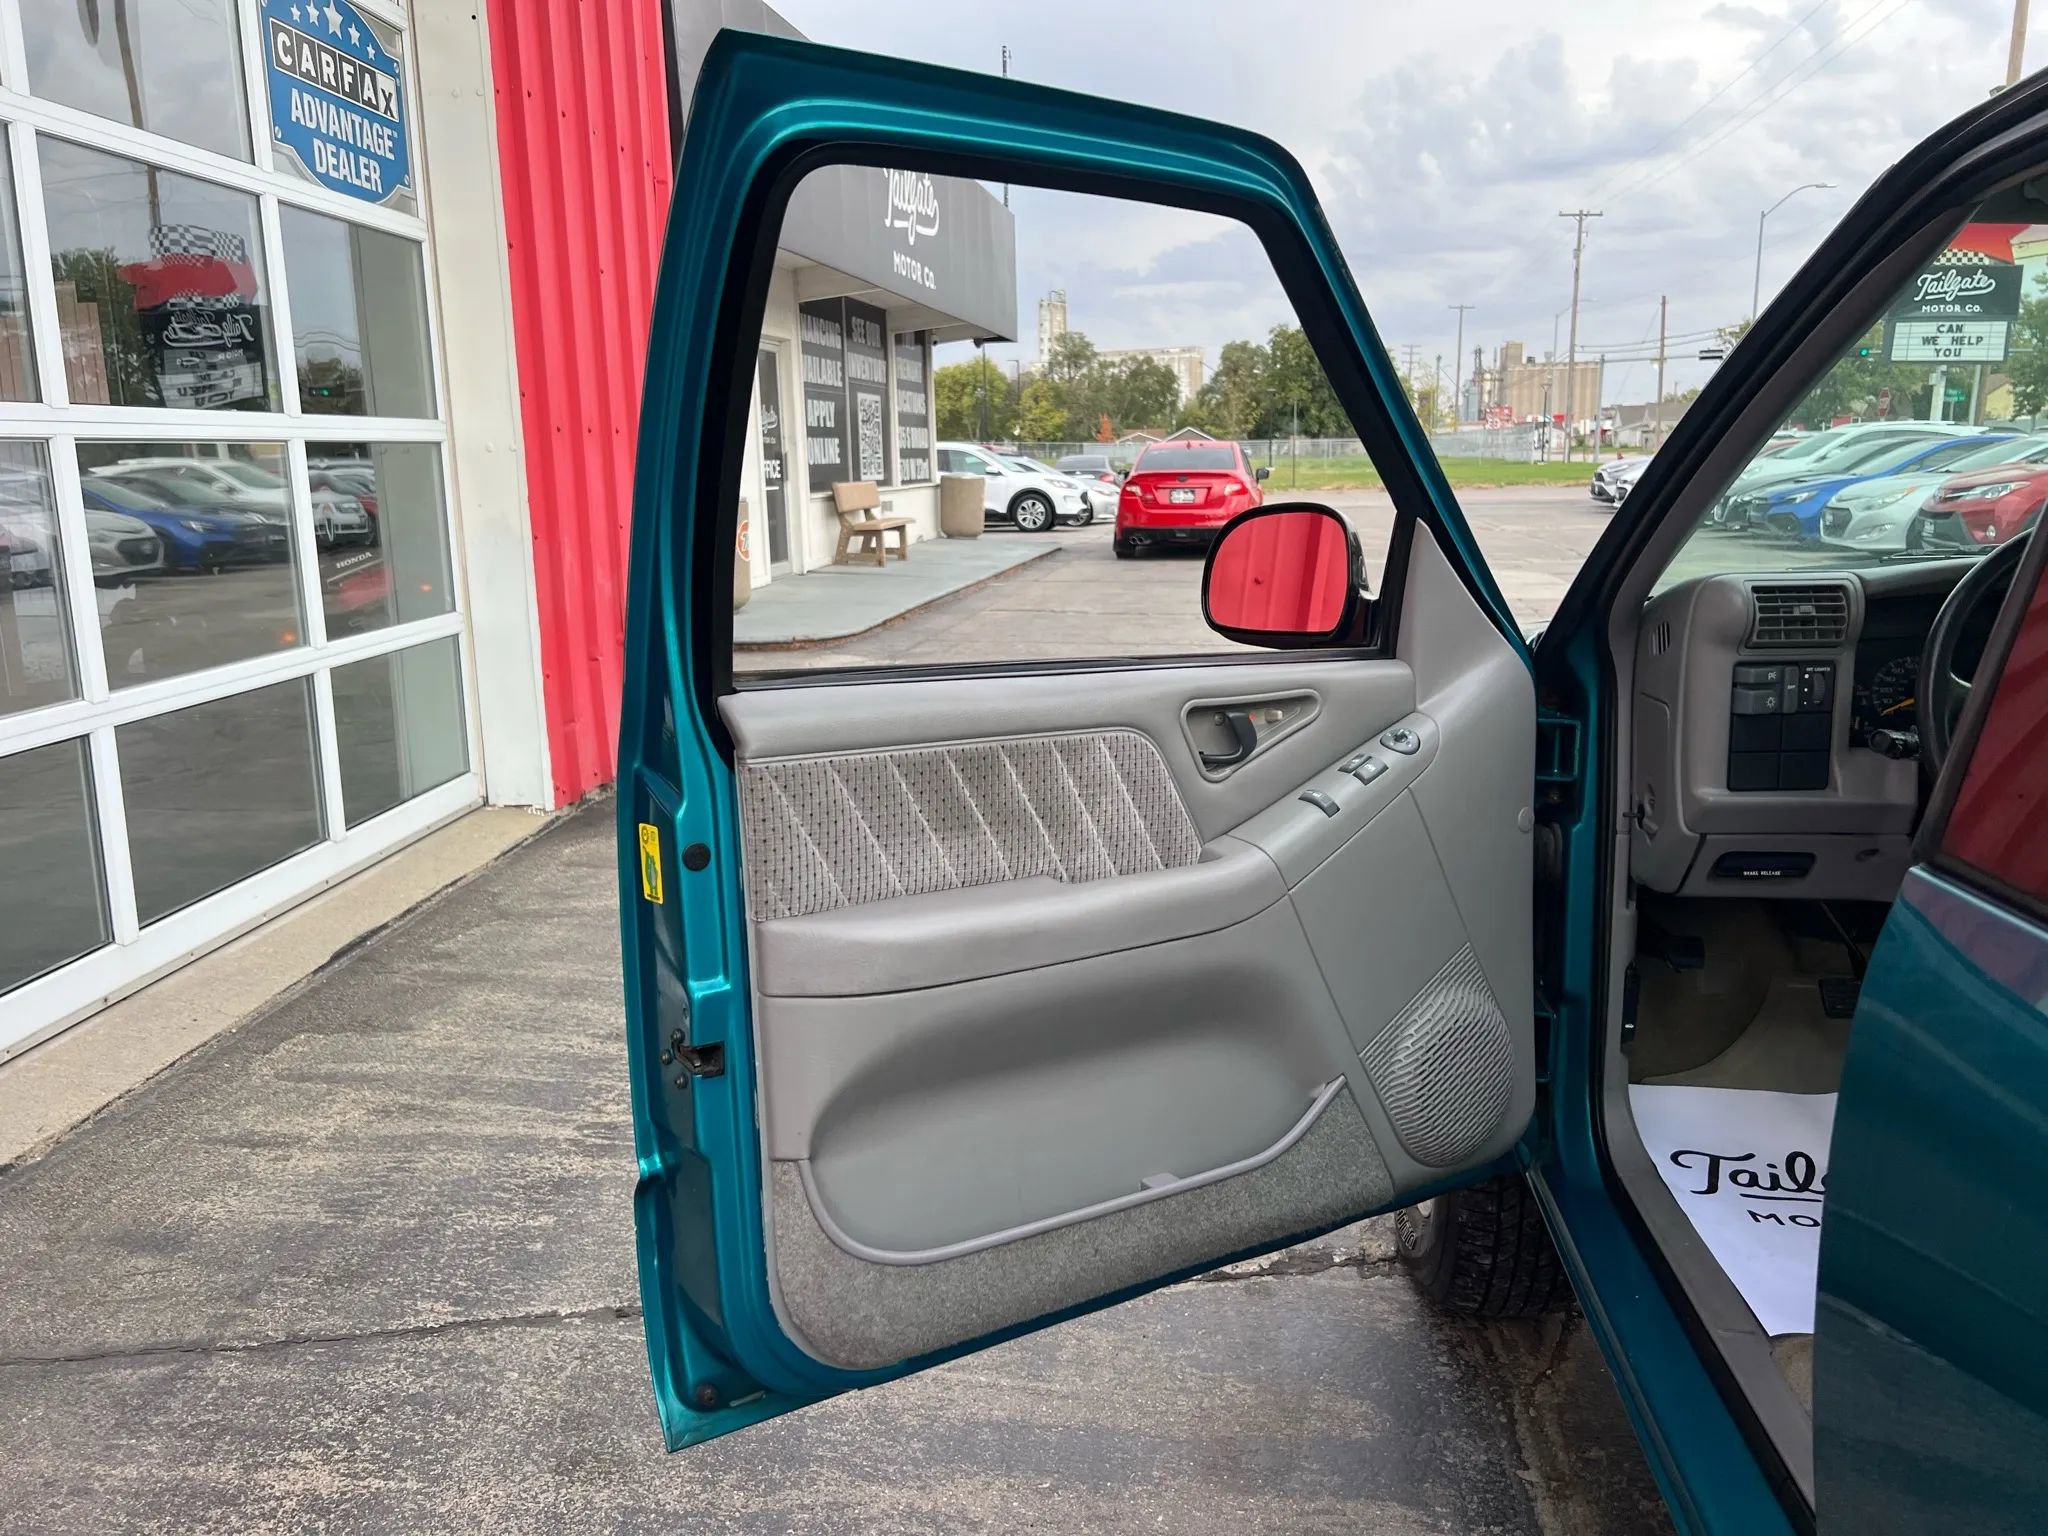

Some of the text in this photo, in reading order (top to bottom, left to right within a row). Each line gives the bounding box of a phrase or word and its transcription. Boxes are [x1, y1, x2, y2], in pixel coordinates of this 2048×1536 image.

[276, 32, 396, 118] CARFAX
[290, 88, 396, 160] ADVANTAGE
[312, 137, 383, 193] DEALER
[883, 167, 940, 246] Tailgate
[893, 250, 923, 285] MOTOR
[1913, 269, 1996, 301] Tailgate
[1921, 304, 1983, 313] MOTOR CO.
[851, 316, 866, 344] SEE
[1921, 335, 1984, 346] WE HELP
[1936, 323, 1964, 334] CAN
[1934, 347, 1962, 358] YOU
[806, 399, 836, 428] APPLY
[807, 437, 841, 466] ONLINE
[335, 551, 373, 569] HONDA
